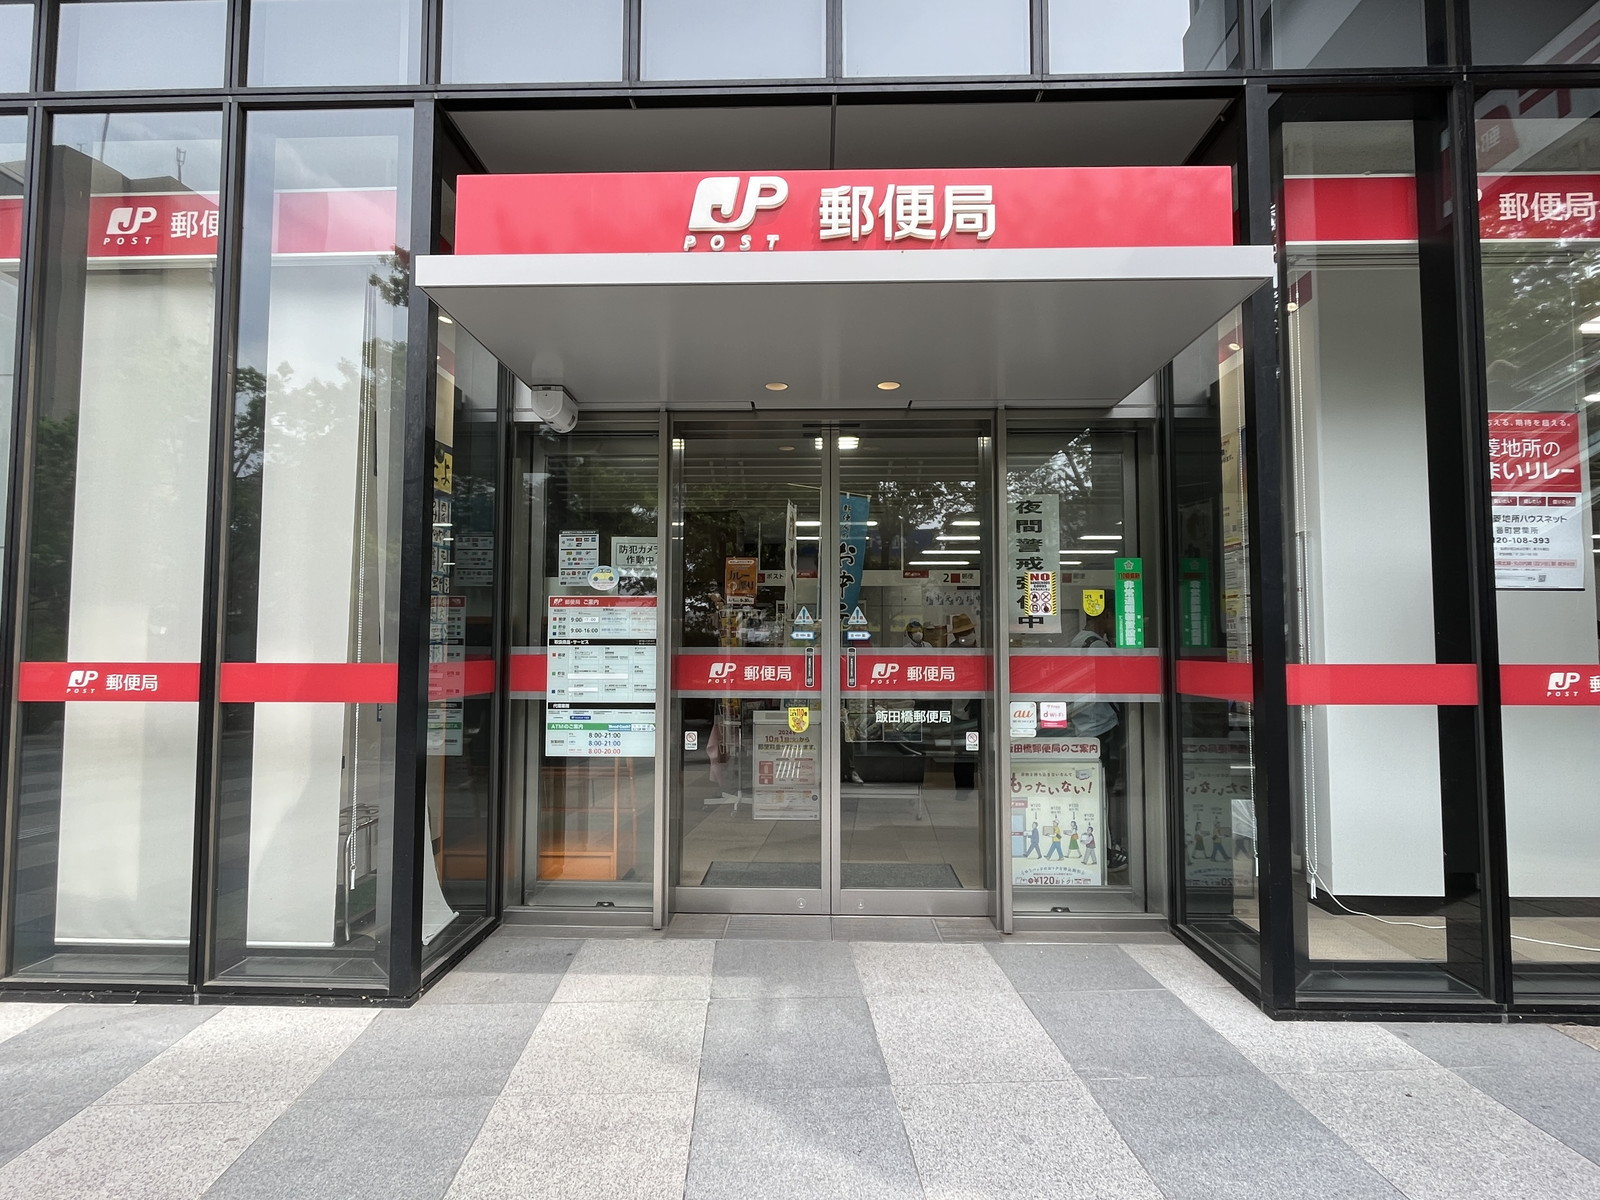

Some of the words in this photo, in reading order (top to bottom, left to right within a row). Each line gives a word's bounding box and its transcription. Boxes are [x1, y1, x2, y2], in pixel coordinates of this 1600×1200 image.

[688, 176, 788, 231] JP
[1499, 192, 1597, 221] 郵便局
[106, 207, 157, 234] JP
[819, 183, 996, 242] 郵便局
[103, 236, 152, 245] POST
[683, 234, 780, 251] POST
[626, 556, 654, 564] 作動中
[943, 573, 949, 583] 2
[1029, 573, 1050, 581] NO
[709, 662, 736, 678] JP
[744, 665, 792, 681] 郵便局
[872, 663, 899, 678] JP
[906, 666, 955, 682] 郵便局
[68, 670, 98, 687] JP
[105, 674, 158, 691] 郵便局
[1548, 672, 1580, 690] JP
[875, 710, 951, 724] 飯田橋郵便局
[1013, 710, 1033, 718] au
